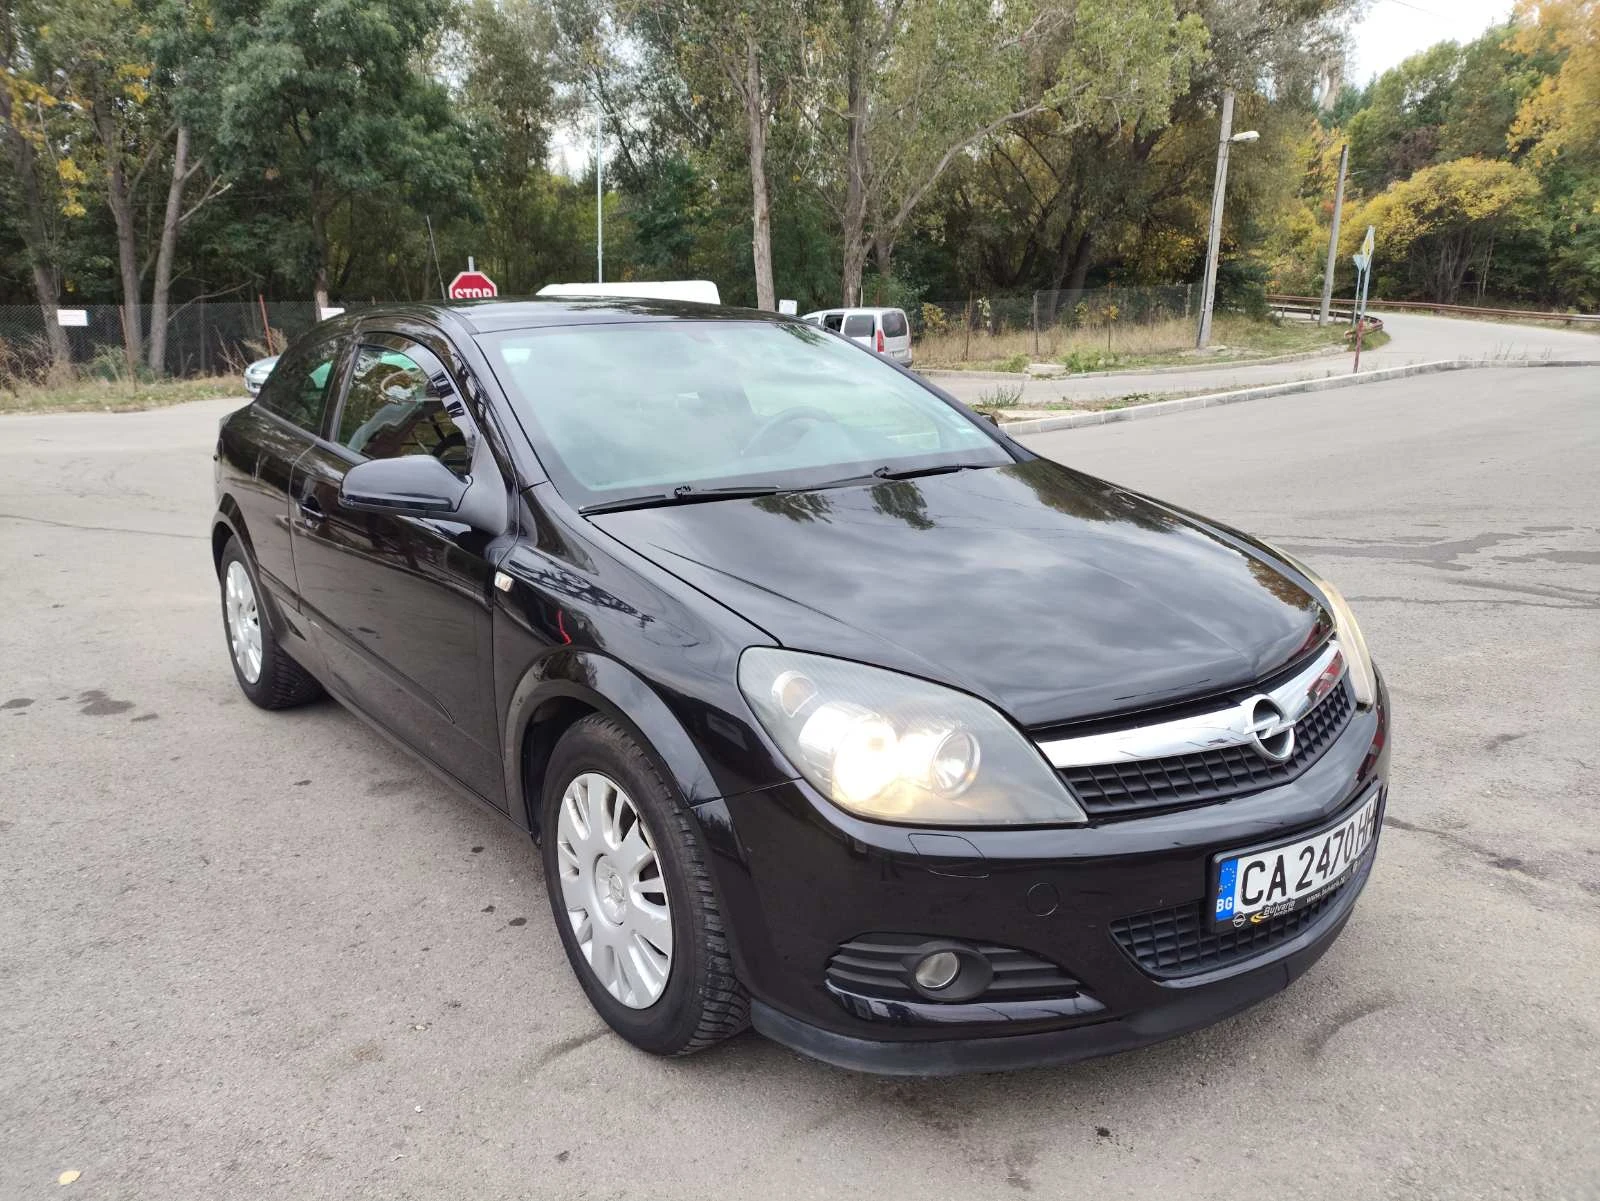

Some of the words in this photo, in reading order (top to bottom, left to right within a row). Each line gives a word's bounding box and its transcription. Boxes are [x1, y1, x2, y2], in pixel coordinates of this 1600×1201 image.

[454, 288, 493, 299] STOP
[1241, 854, 1286, 906] CA
[1296, 821, 1354, 892] 2470
[1216, 897, 1232, 912] BG
